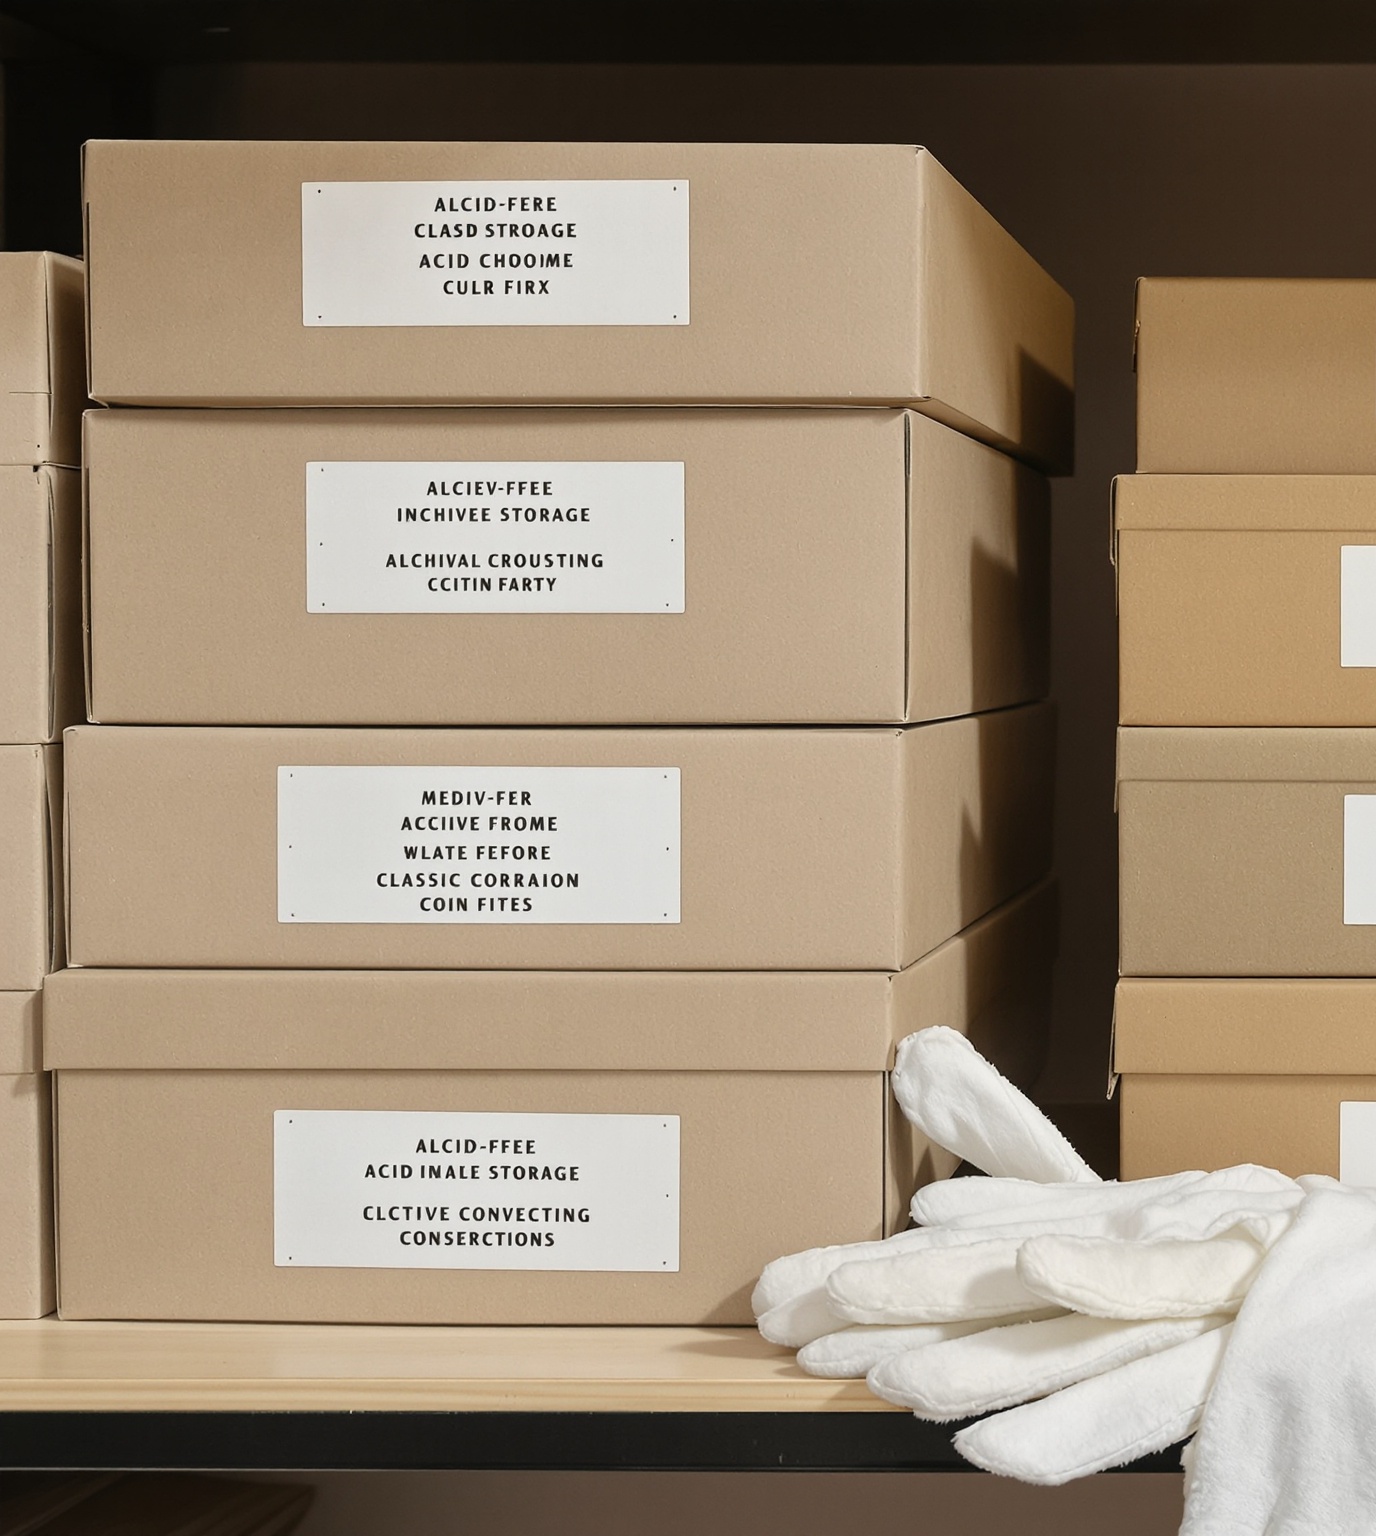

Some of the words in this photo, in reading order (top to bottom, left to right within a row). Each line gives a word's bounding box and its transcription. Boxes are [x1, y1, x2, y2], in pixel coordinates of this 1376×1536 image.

[434, 196, 557, 213] ALCID-FERE
[414, 223, 478, 239] CLASD
[485, 222, 577, 239] STROAGE
[418, 253, 470, 269] ACID
[442, 279, 495, 296] CULR
[504, 279, 549, 295] FIRX
[426, 480, 553, 496] ALCIEV-FFEE
[397, 507, 491, 523] INCHIVEE
[500, 507, 590, 523] STORAGE
[385, 553, 481, 569] ALCHIVAL
[487, 553, 604, 569] CROUSTING
[427, 577, 492, 592] CCITIN
[498, 577, 557, 592] FARTY
[421, 790, 532, 806] MEDIV-FER
[400, 816, 480, 832] ACCIIVE
[488, 816, 558, 832] FROME
[403, 845, 468, 861] WLATE
[476, 845, 551, 861] FEFORE
[376, 872, 461, 888] CLASSIC
[470, 872, 579, 889] CORRAION
[419, 896, 468, 912] COIN
[477, 897, 533, 912] FITES
[415, 1138, 536, 1155] ALCID-FFEE
[364, 1163, 413, 1179] ACID
[488, 1165, 580, 1182] STORAGE
[362, 1205, 450, 1222] CLCTIVE
[458, 1206, 590, 1223] CONVECTING
[399, 1230, 555, 1247] CONSERCTIONS
